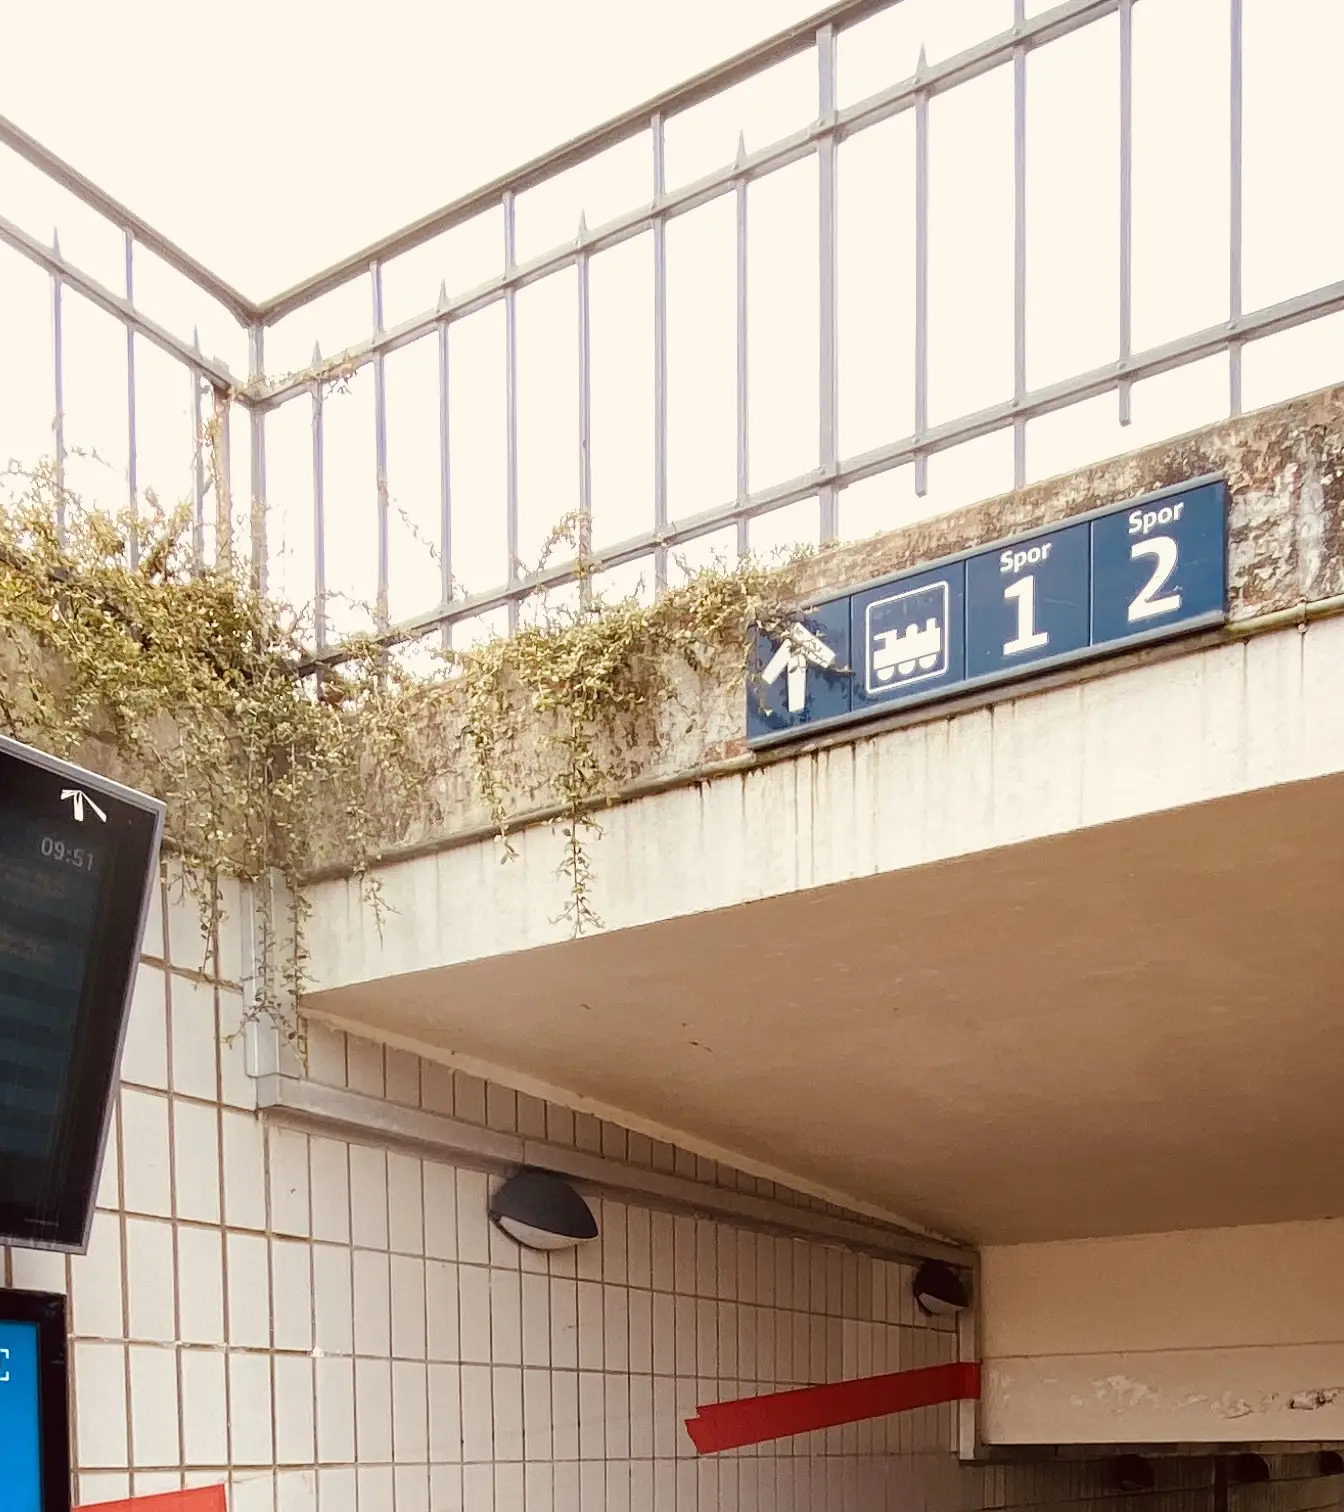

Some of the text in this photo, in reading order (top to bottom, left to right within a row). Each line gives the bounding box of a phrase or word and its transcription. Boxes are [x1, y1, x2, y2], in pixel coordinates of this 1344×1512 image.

[1128, 501, 1184, 535] Spor
[999, 541, 1052, 574] Spor
[1127, 536, 1181, 622] 2
[1002, 574, 1050, 656] 1
[40, 836, 95, 872] 09:51
